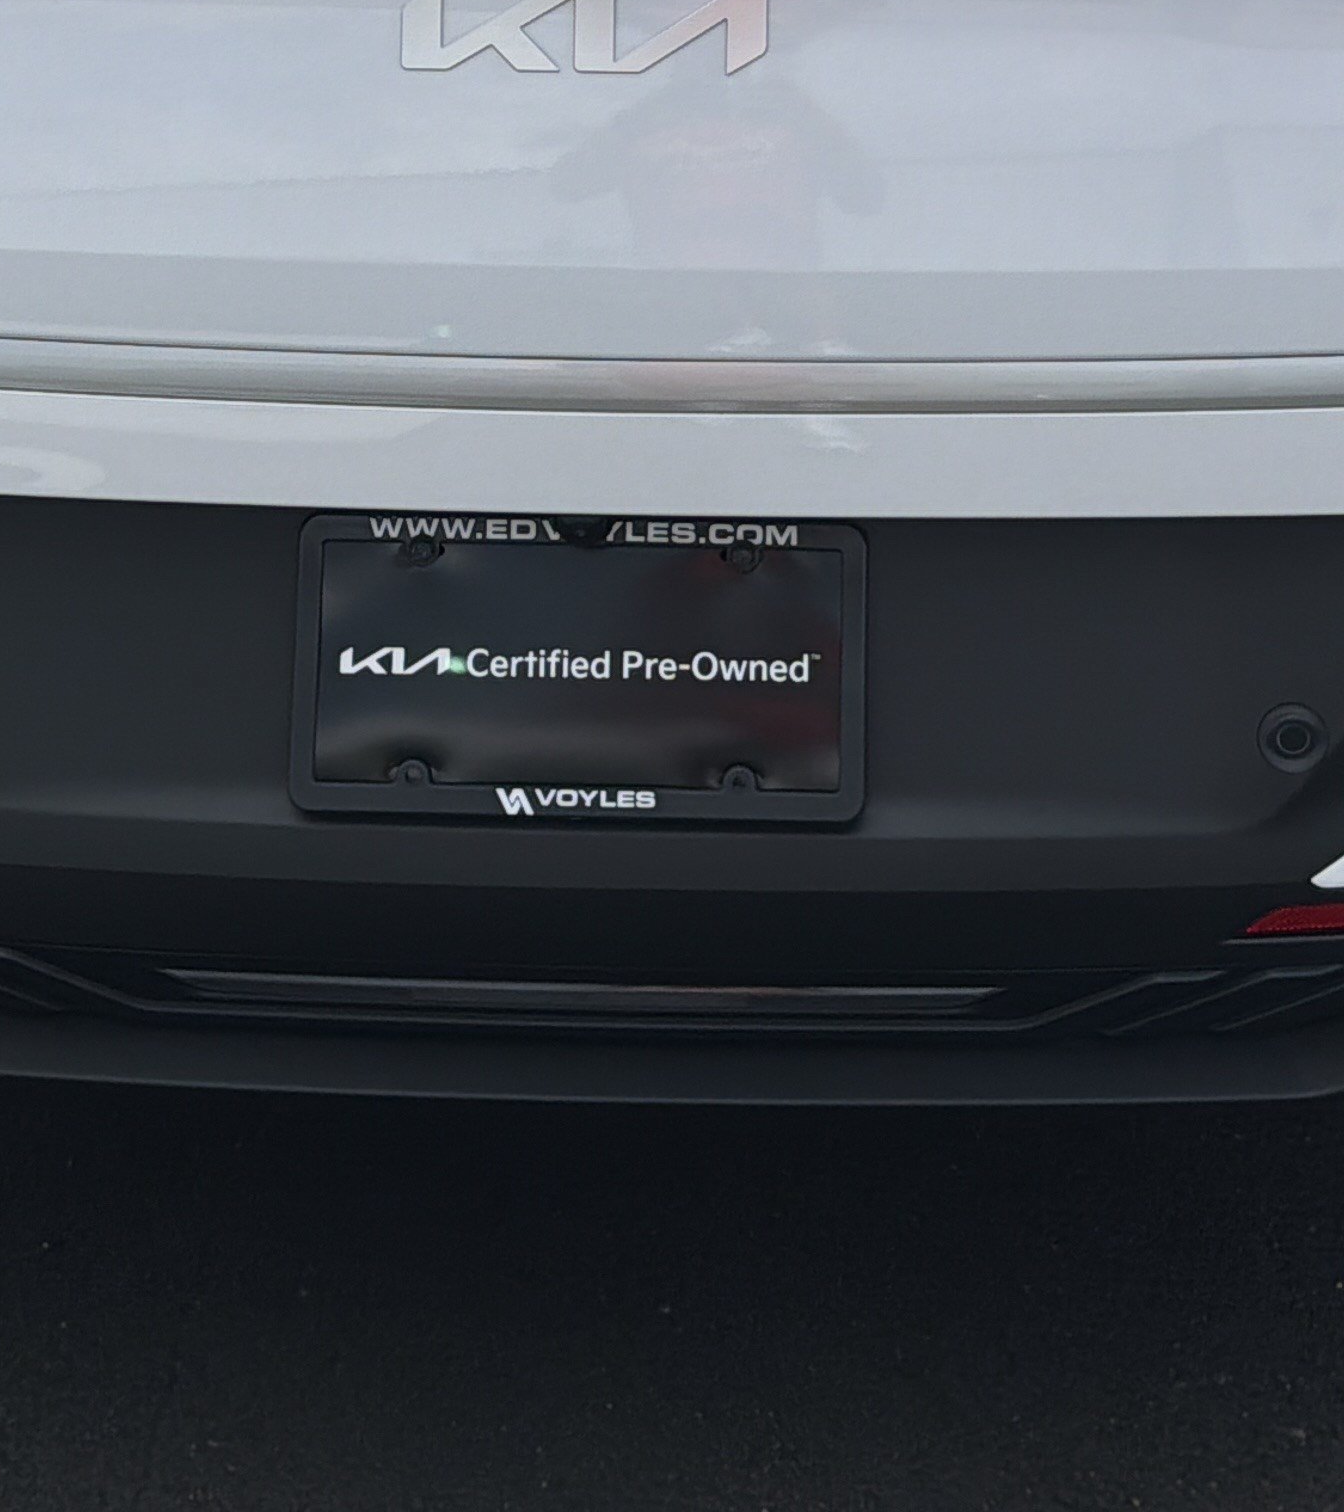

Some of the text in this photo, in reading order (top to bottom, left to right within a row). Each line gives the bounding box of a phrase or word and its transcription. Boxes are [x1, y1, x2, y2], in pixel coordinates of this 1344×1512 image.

[369, 515, 799, 547] WWW.EDVYLES.COM
[339, 646, 452, 676] KIA
[465, 647, 611, 680] Certified
[534, 787, 657, 810] VOYLES
